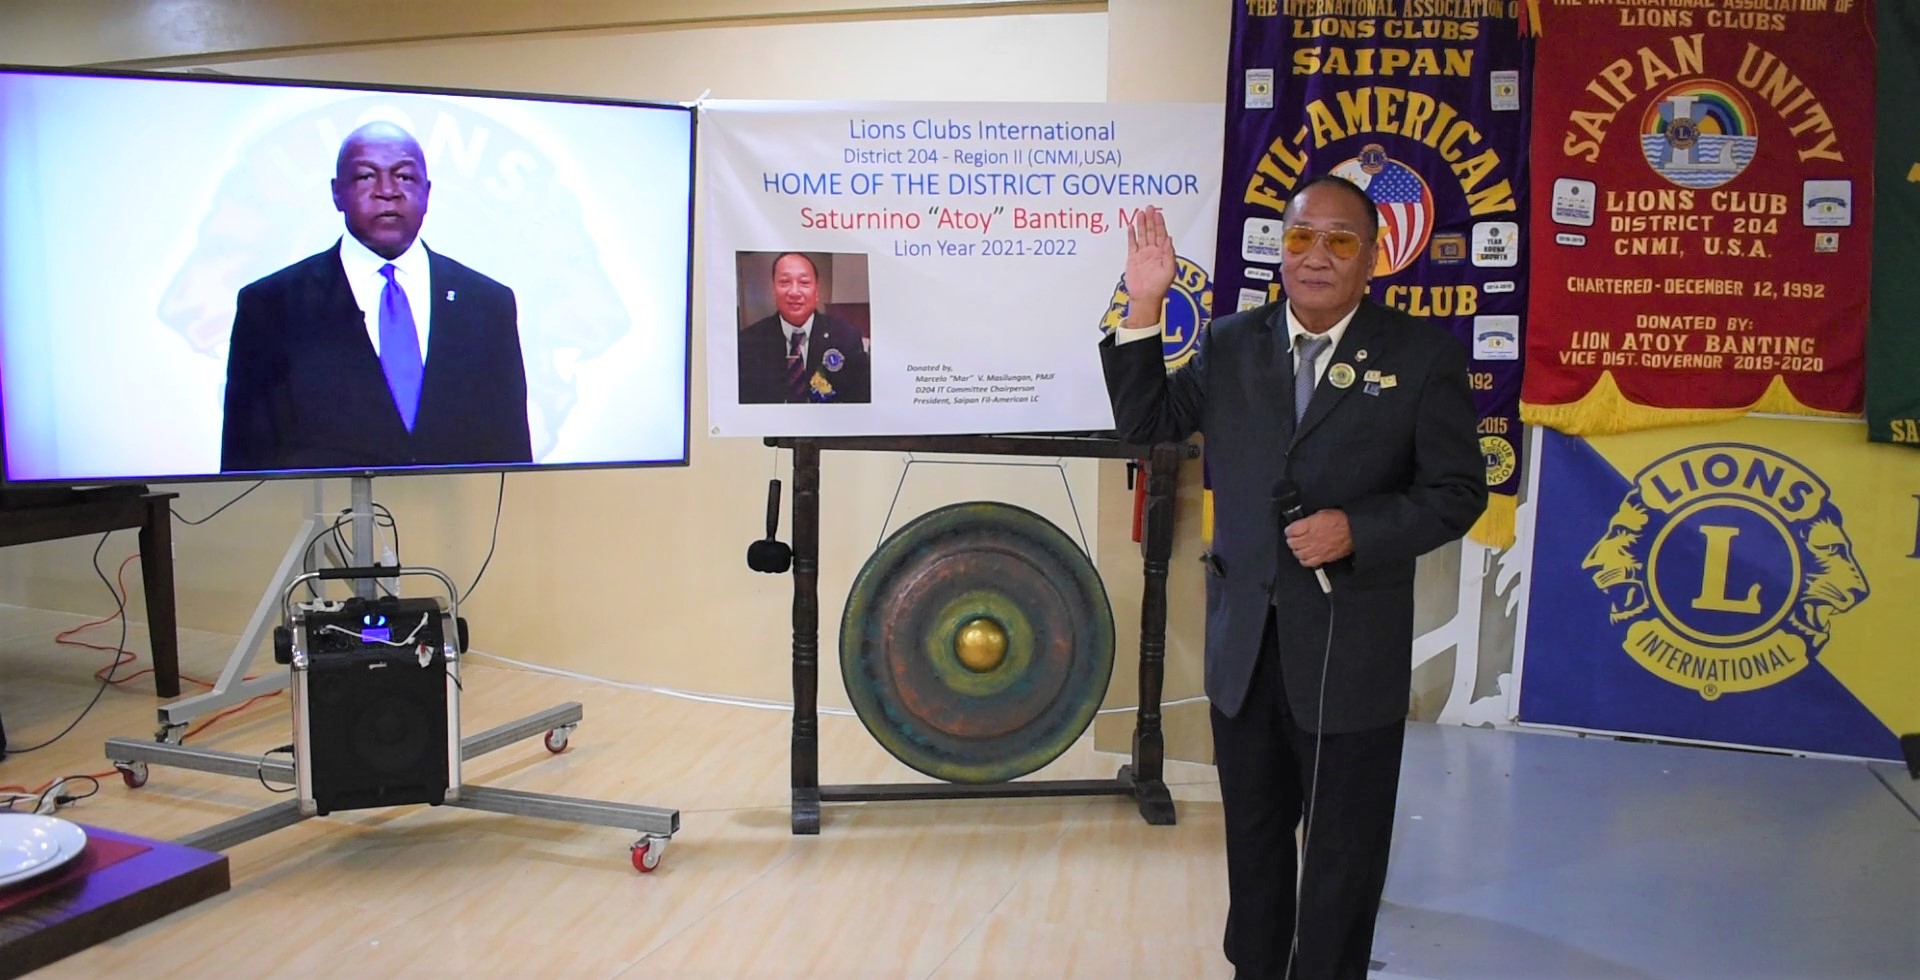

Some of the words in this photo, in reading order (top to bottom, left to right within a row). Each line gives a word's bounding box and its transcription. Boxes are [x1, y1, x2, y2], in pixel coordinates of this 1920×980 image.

[1246, 0, 1278, 17] THE
[1283, 0, 1397, 17] INTERNATIONAL
[1403, 0, 1504, 19] ASSOCIATION
[1508, 1, 1519, 19] O
[1619, 8, 1693, 28] LIONS
[1707, 10, 1786, 31] CLUBS
[1292, 17, 1376, 39] LIONS
[1384, 18, 1479, 41] CLUBS
[1292, 45, 1474, 77] SAIPAN
[1563, 32, 1706, 163] SAIPAN
[1737, 42, 1844, 163] UNITY
[849, 119, 906, 139] Lions
[912, 119, 972, 140] Clubs
[979, 120, 1116, 141] International
[844, 148, 902, 164] District
[907, 149, 939, 164] 204
[954, 149, 1008, 168] Region
[1028, 149, 1122, 168] (CNMI,USA)
[1244, 85, 1517, 217] FIL-AMERICAN
[763, 172, 843, 195] HOME
[851, 173, 884, 195] OF
[891, 173, 940, 195] THE
[949, 174, 1056, 195] DISTRICT
[1063, 173, 1199, 196] GOVERNOR
[1606, 190, 1694, 212] LIONS
[1711, 190, 1788, 215] CLUB
[801, 206, 921, 230] Saturnino
[928, 205, 1004, 234] “Atoy”
[1013, 207, 1110, 234] Banting,
[1611, 215, 1714, 233] DISTRICT
[1733, 218, 1778, 235] 204
[894, 240, 931, 256] Lion
[937, 240, 976, 257] Year
[981, 239, 1077, 256] 2021-2022
[1614, 237, 1685, 259] CNMI,
[1704, 239, 1772, 259] U.S.A.
[1385, 285, 1478, 318] CLUB
[1783, 281, 1825, 299] 1992
[1636, 314, 1717, 331] DONATED
[1727, 317, 1754, 331] BY:
[1571, 331, 1610, 351] LION
[1621, 333, 1688, 352] ATOY
[1705, 335, 1815, 355] BANTING
[907, 364, 940, 372] Donated
[1559, 351, 1596, 366] VICE
[1641, 353, 1723, 369] GOVERNOR
[1734, 355, 1824, 371] 2019-2020
[946, 385, 988, 393] Committee
[990, 385, 1035, 394] Chairperson
[953, 396, 979, 405] Saipan
[1476, 417, 1508, 434] 2015
[1889, 419, 1920, 443] SA
[1650, 453, 1817, 513] LIONS
[1691, 524, 1763, 616] L
[1636, 629, 1797, 682] INTERNATIONAL
